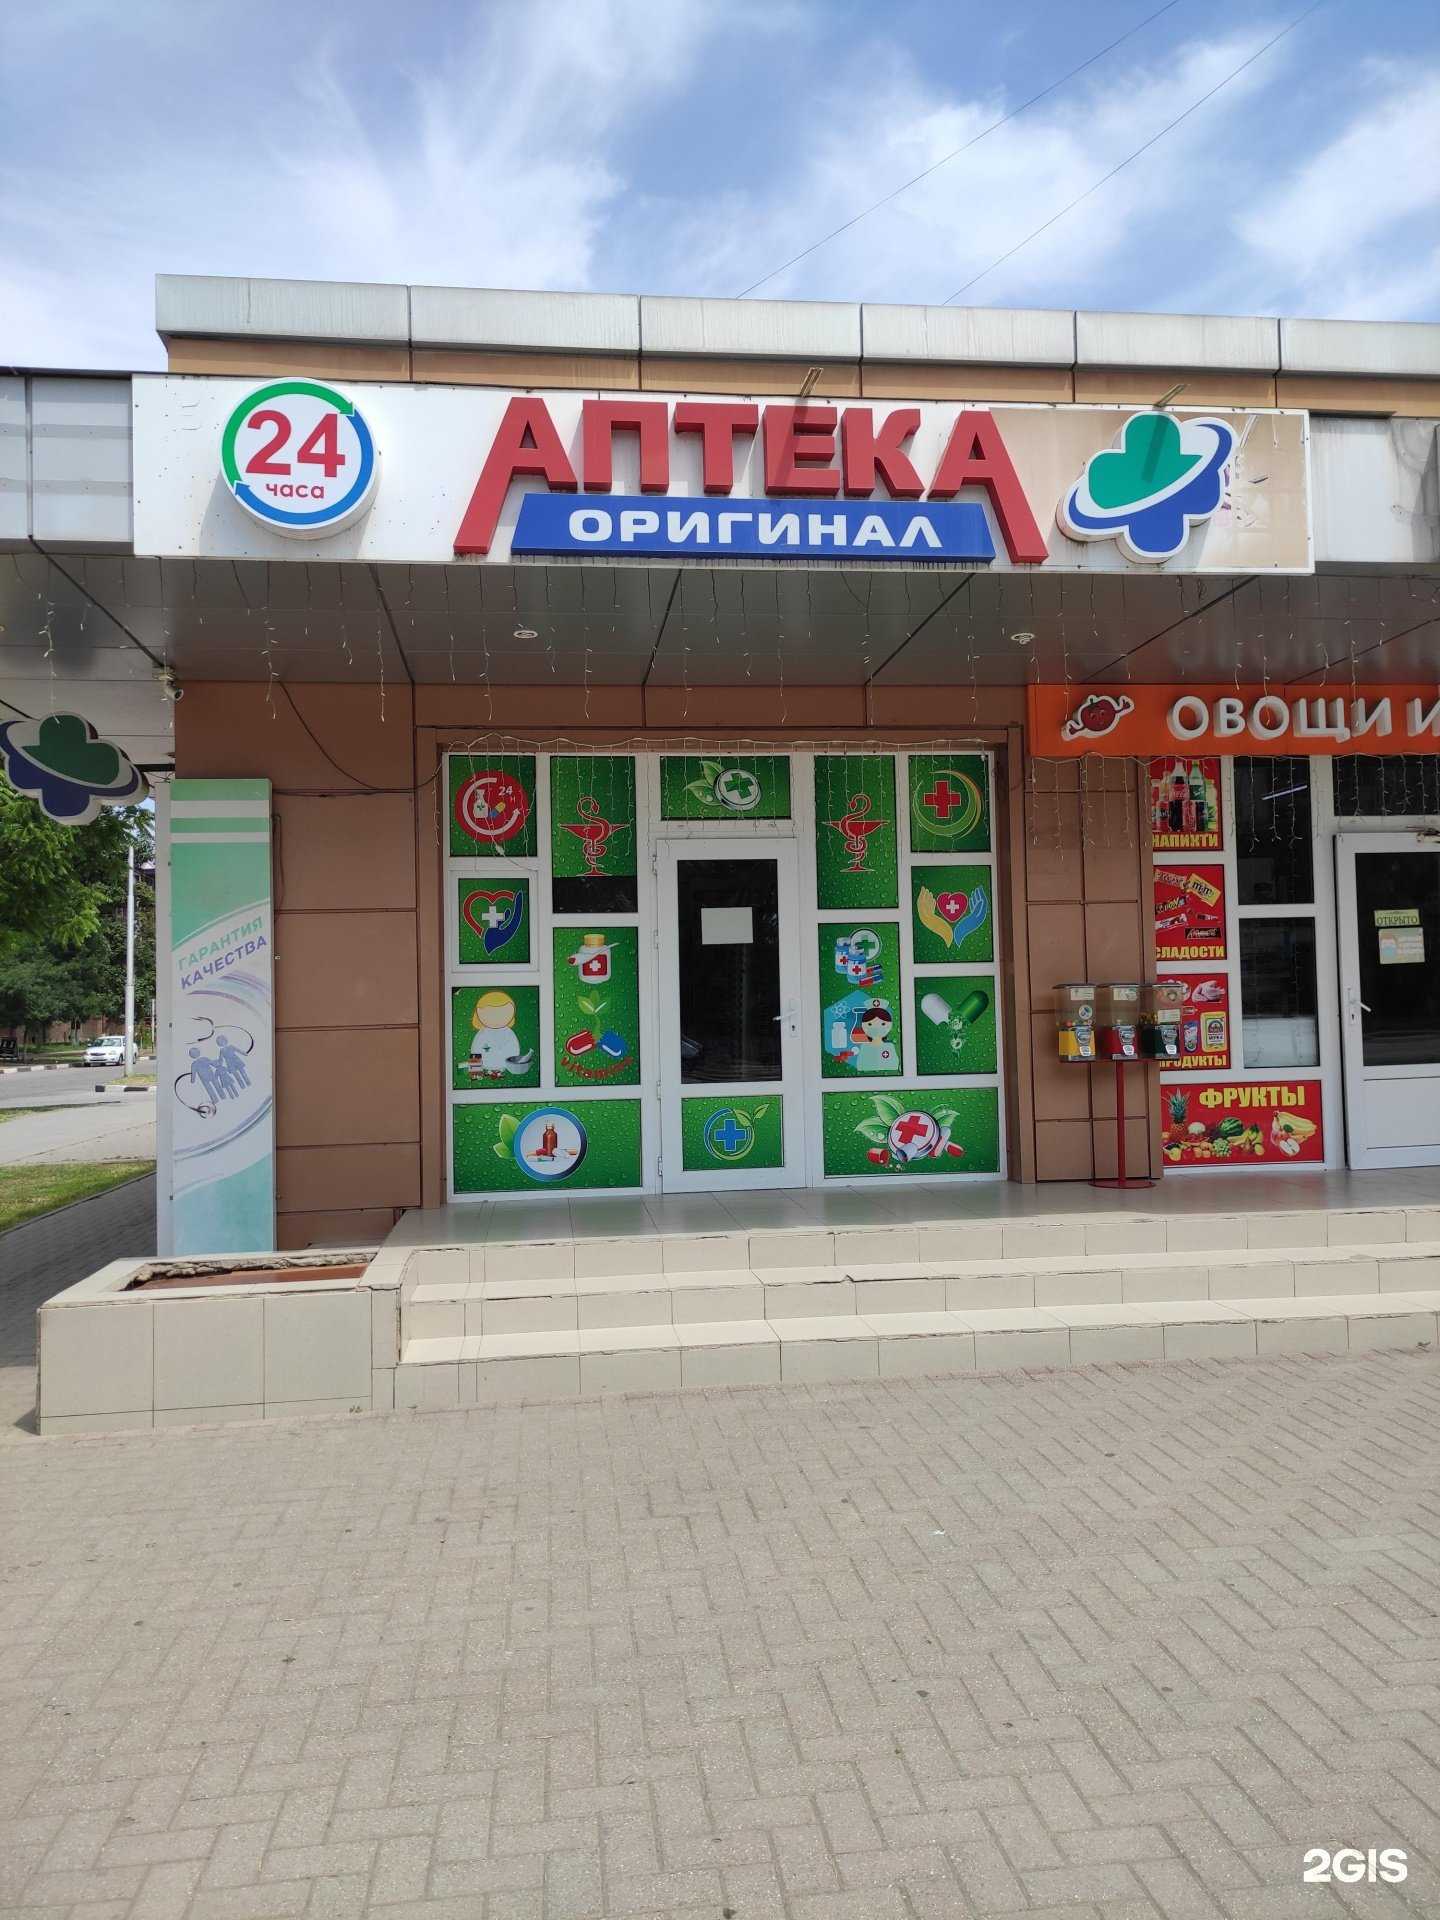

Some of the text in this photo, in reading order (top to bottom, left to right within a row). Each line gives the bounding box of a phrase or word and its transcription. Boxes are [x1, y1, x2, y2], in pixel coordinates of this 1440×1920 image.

[245, 409, 346, 478] 24
[265, 480, 326, 499] часа
[453, 396, 1049, 564] АПТЕКА
[568, 509, 943, 548] ОРИГИНАЛ
[1166, 695, 1393, 743] ОВОЩИ
[499, 785, 513, 796] 24
[178, 915, 263, 971] ГАРАНТИЯ
[181, 935, 267, 990] КАЧЕСТВА
[1199, 1085, 1305, 1108] ФРУКТЫ
